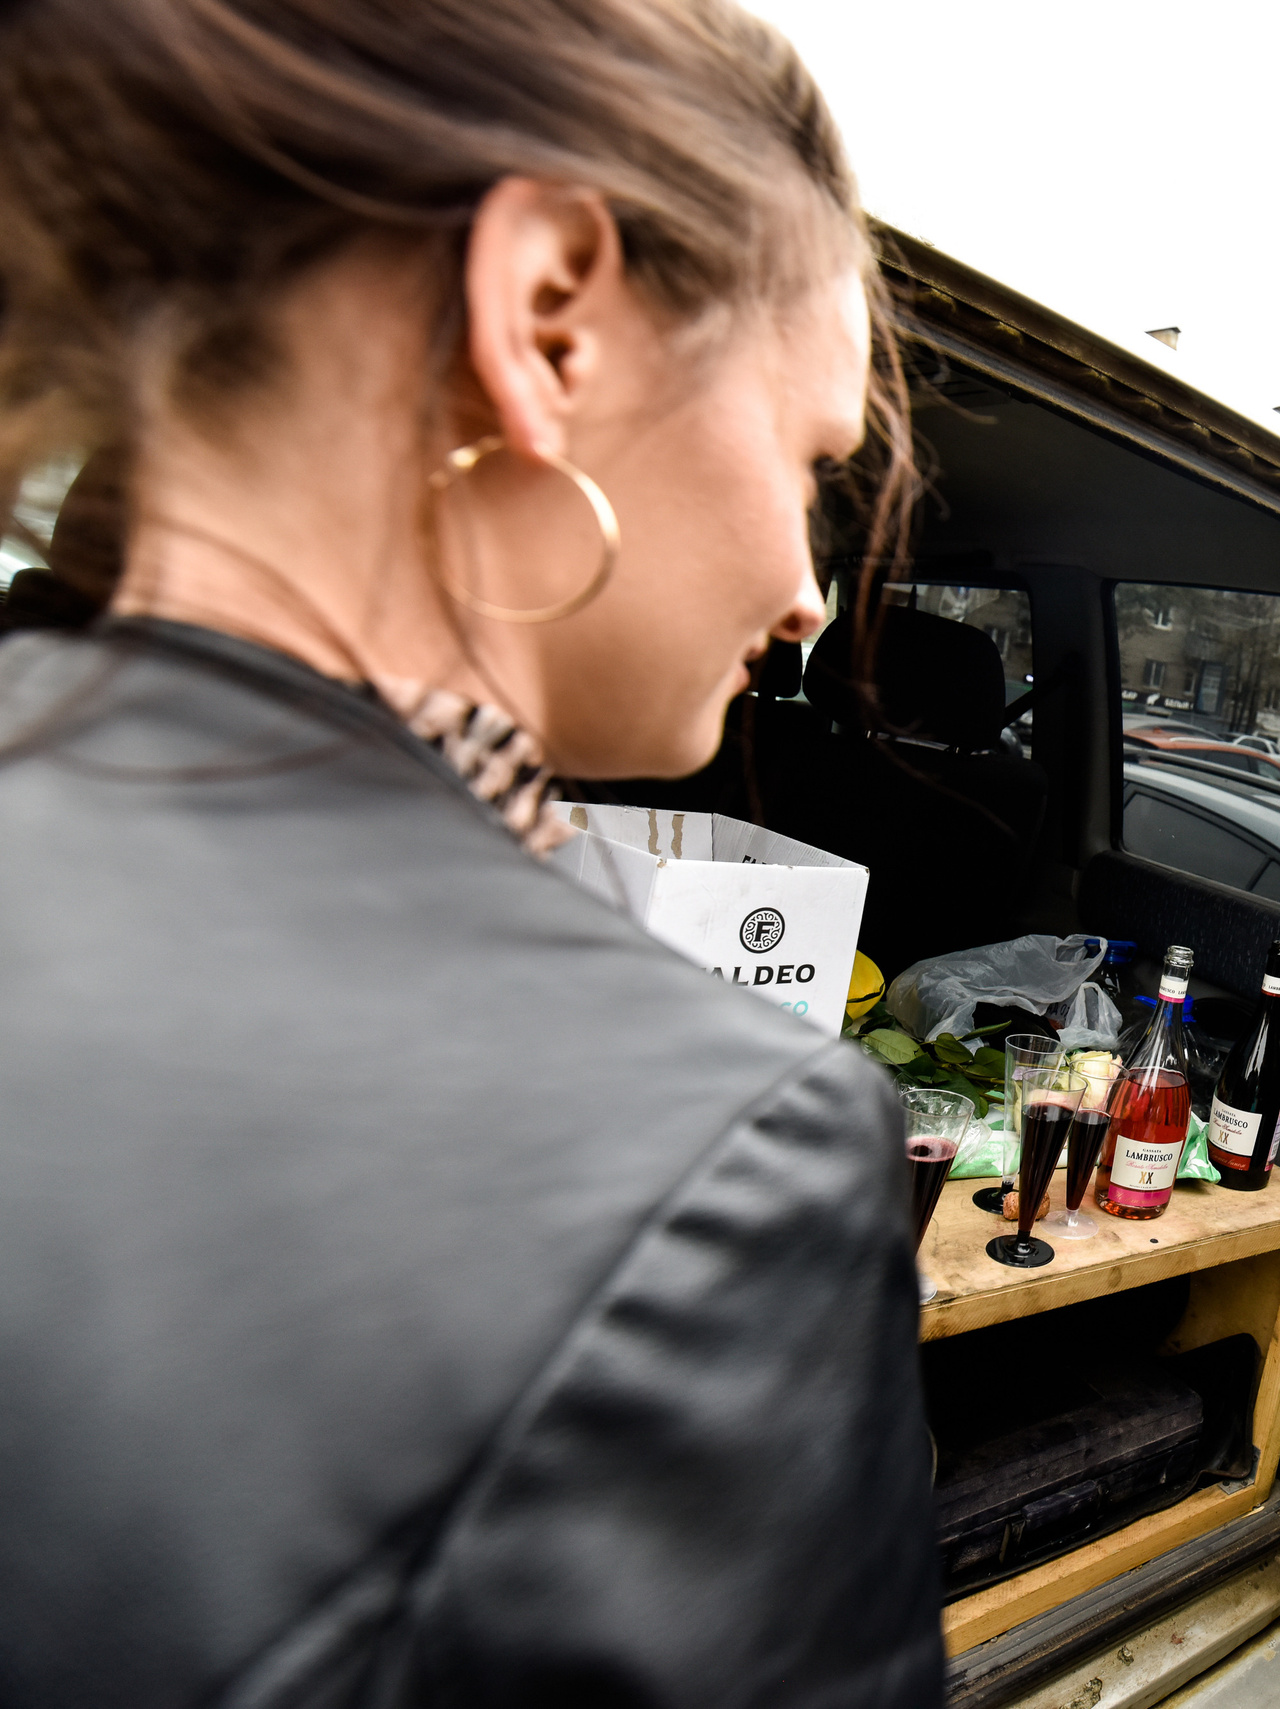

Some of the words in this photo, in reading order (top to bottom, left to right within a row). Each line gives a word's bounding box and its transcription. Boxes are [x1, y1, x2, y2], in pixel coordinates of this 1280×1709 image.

[754, 921, 775, 942] F
[701, 963, 815, 986] ALDEO
[1213, 1108, 1248, 1128] LAMBRUSCO
[1218, 1130, 1229, 1144] XX
[1125, 1149, 1173, 1162] LAMBRUSCO
[1138, 1171, 1154, 1184] XX
